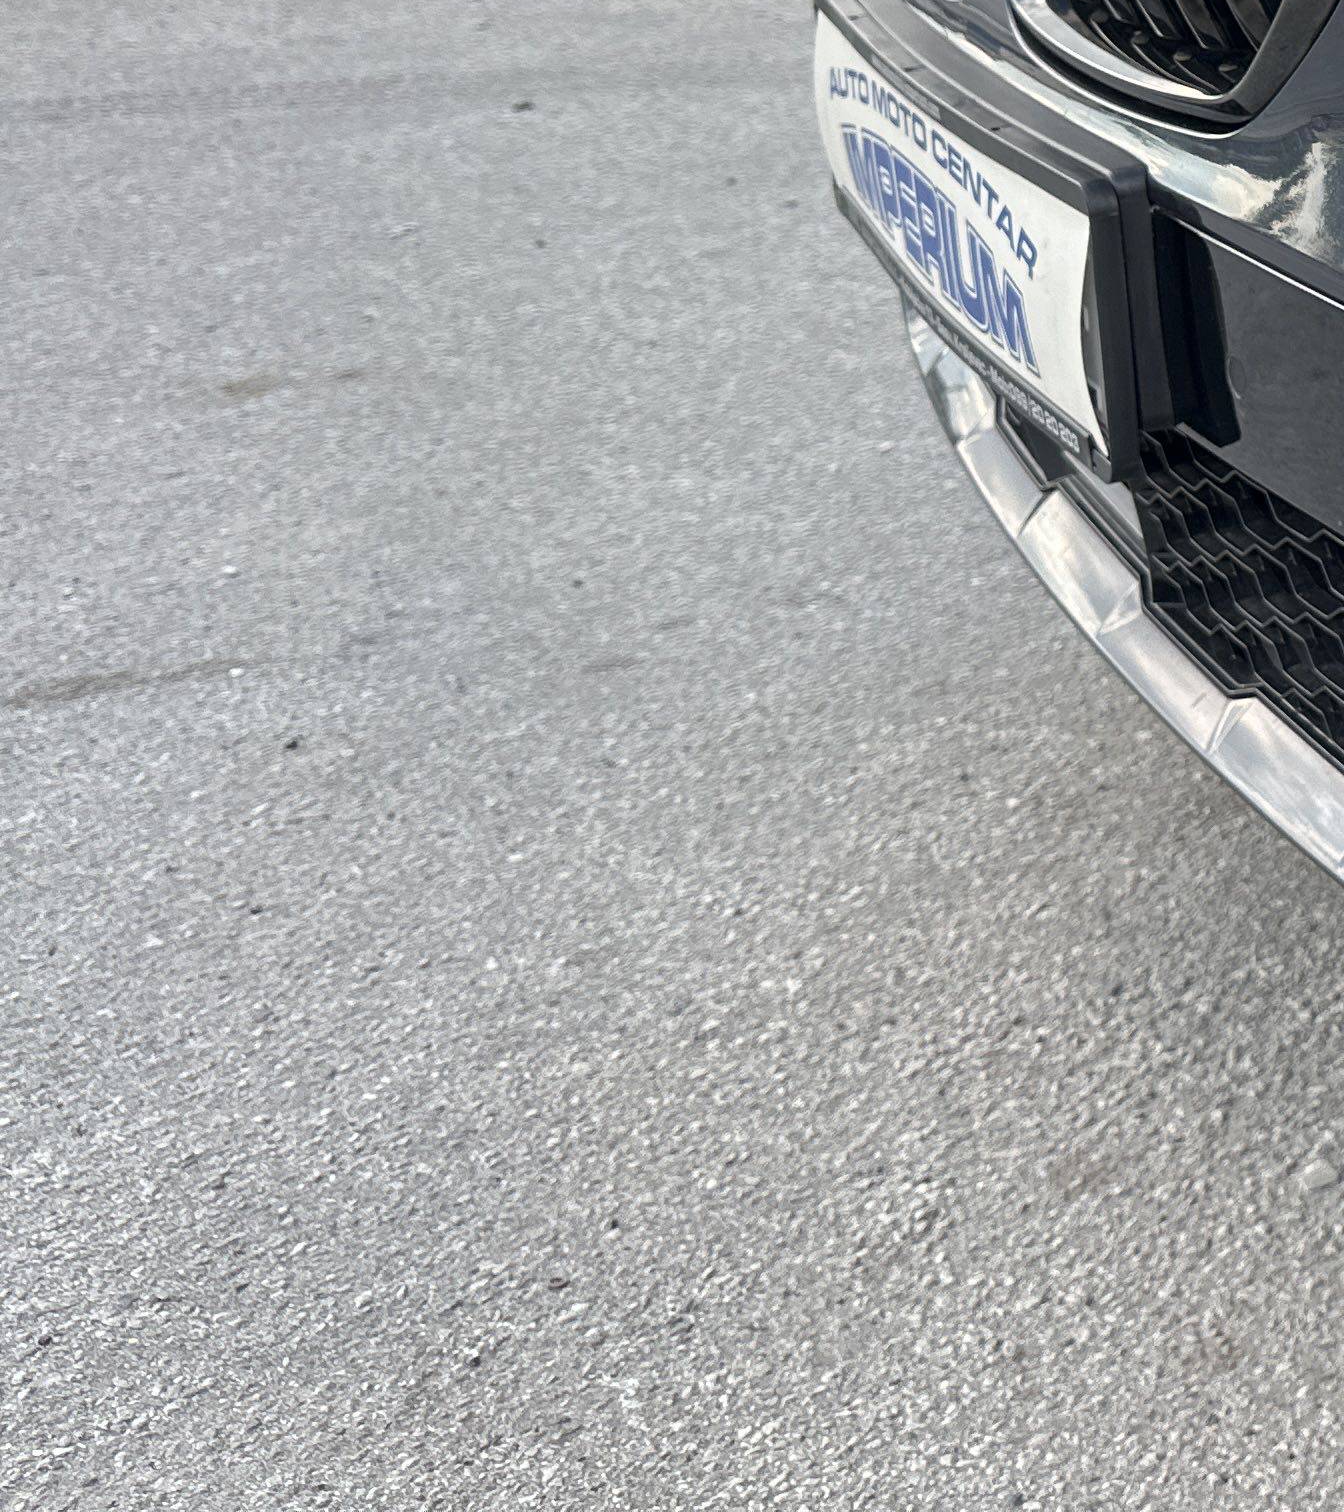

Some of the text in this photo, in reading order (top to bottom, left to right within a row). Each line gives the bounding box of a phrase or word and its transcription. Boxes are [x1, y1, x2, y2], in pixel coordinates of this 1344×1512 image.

[829, 66, 1039, 281] AUTO MOTO CENTAR
[841, 123, 1041, 380] IMPERIUM
